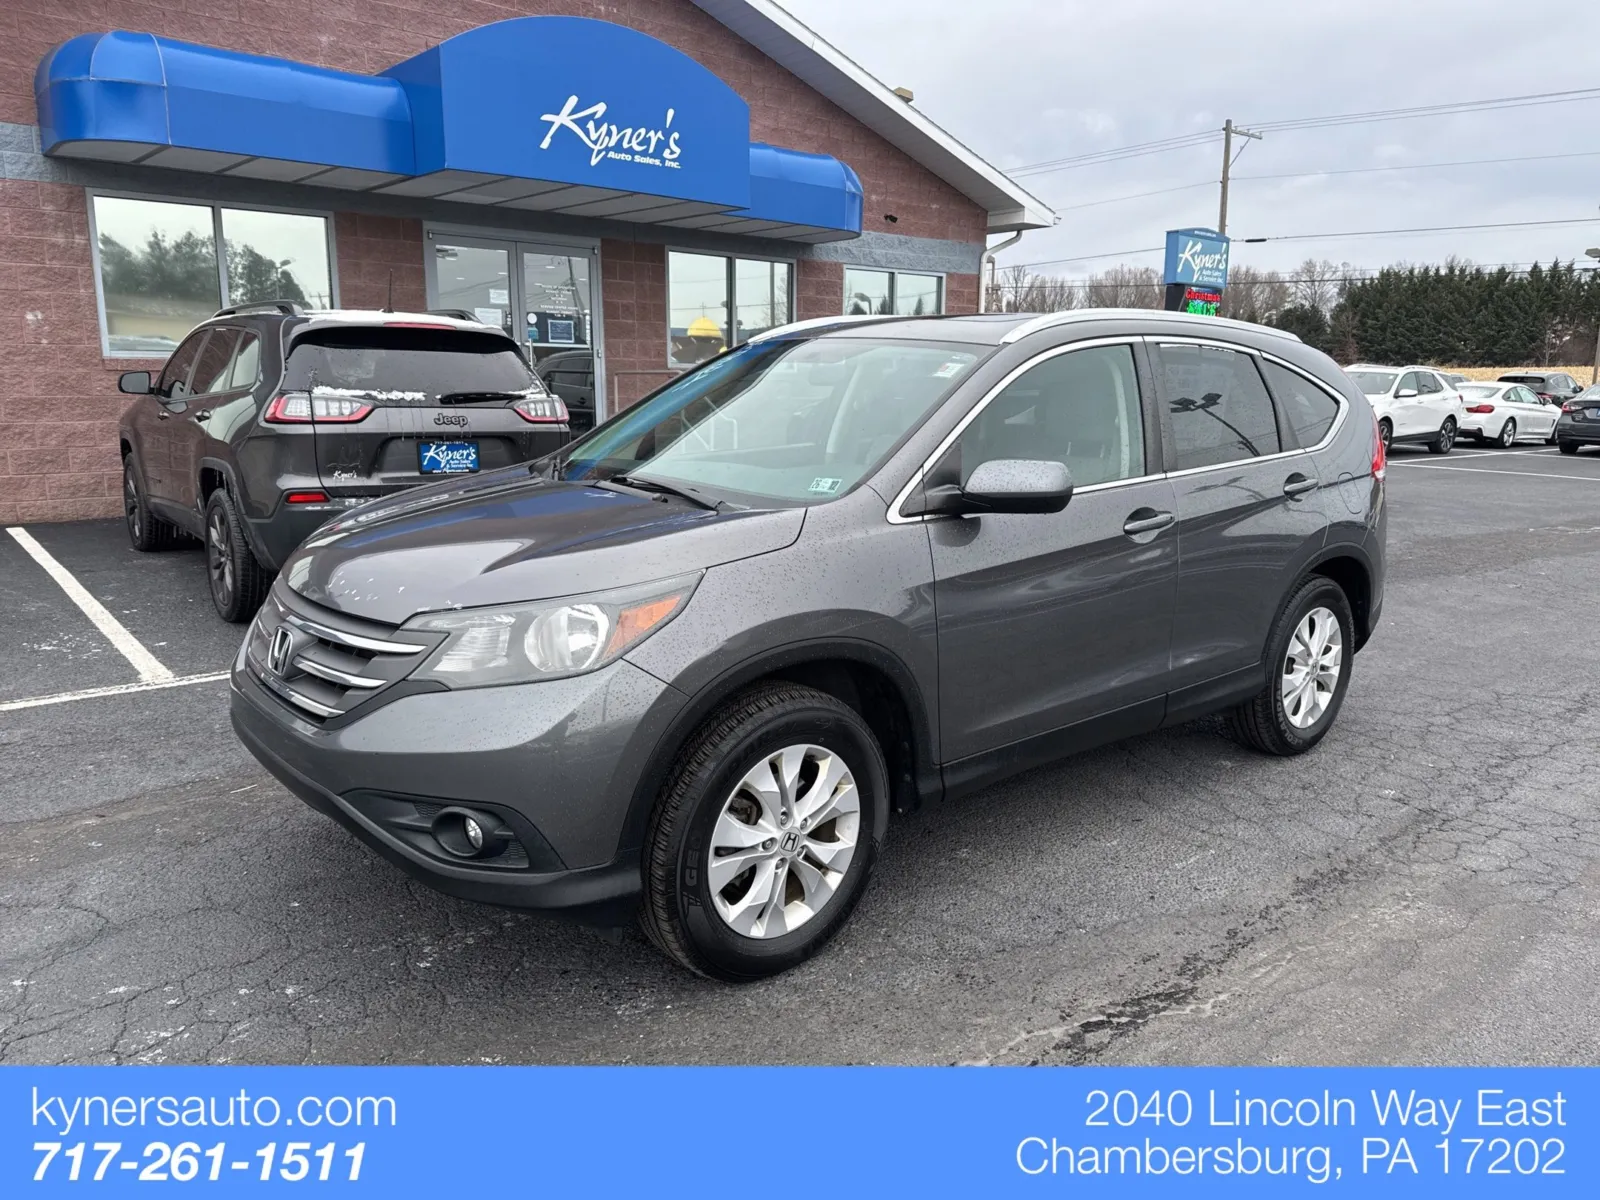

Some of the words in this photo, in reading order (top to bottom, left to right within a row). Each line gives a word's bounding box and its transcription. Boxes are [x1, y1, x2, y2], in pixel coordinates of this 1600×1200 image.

[539, 94, 681, 166] Kyner's
[607, 151, 632, 161] Auto
[634, 154, 662, 167] Sales,
[664, 159, 681, 169] Inc.
[1177, 240, 1227, 283] Kyner's
[434, 412, 468, 428] Jeep
[423, 444, 476, 468] Kyner's
